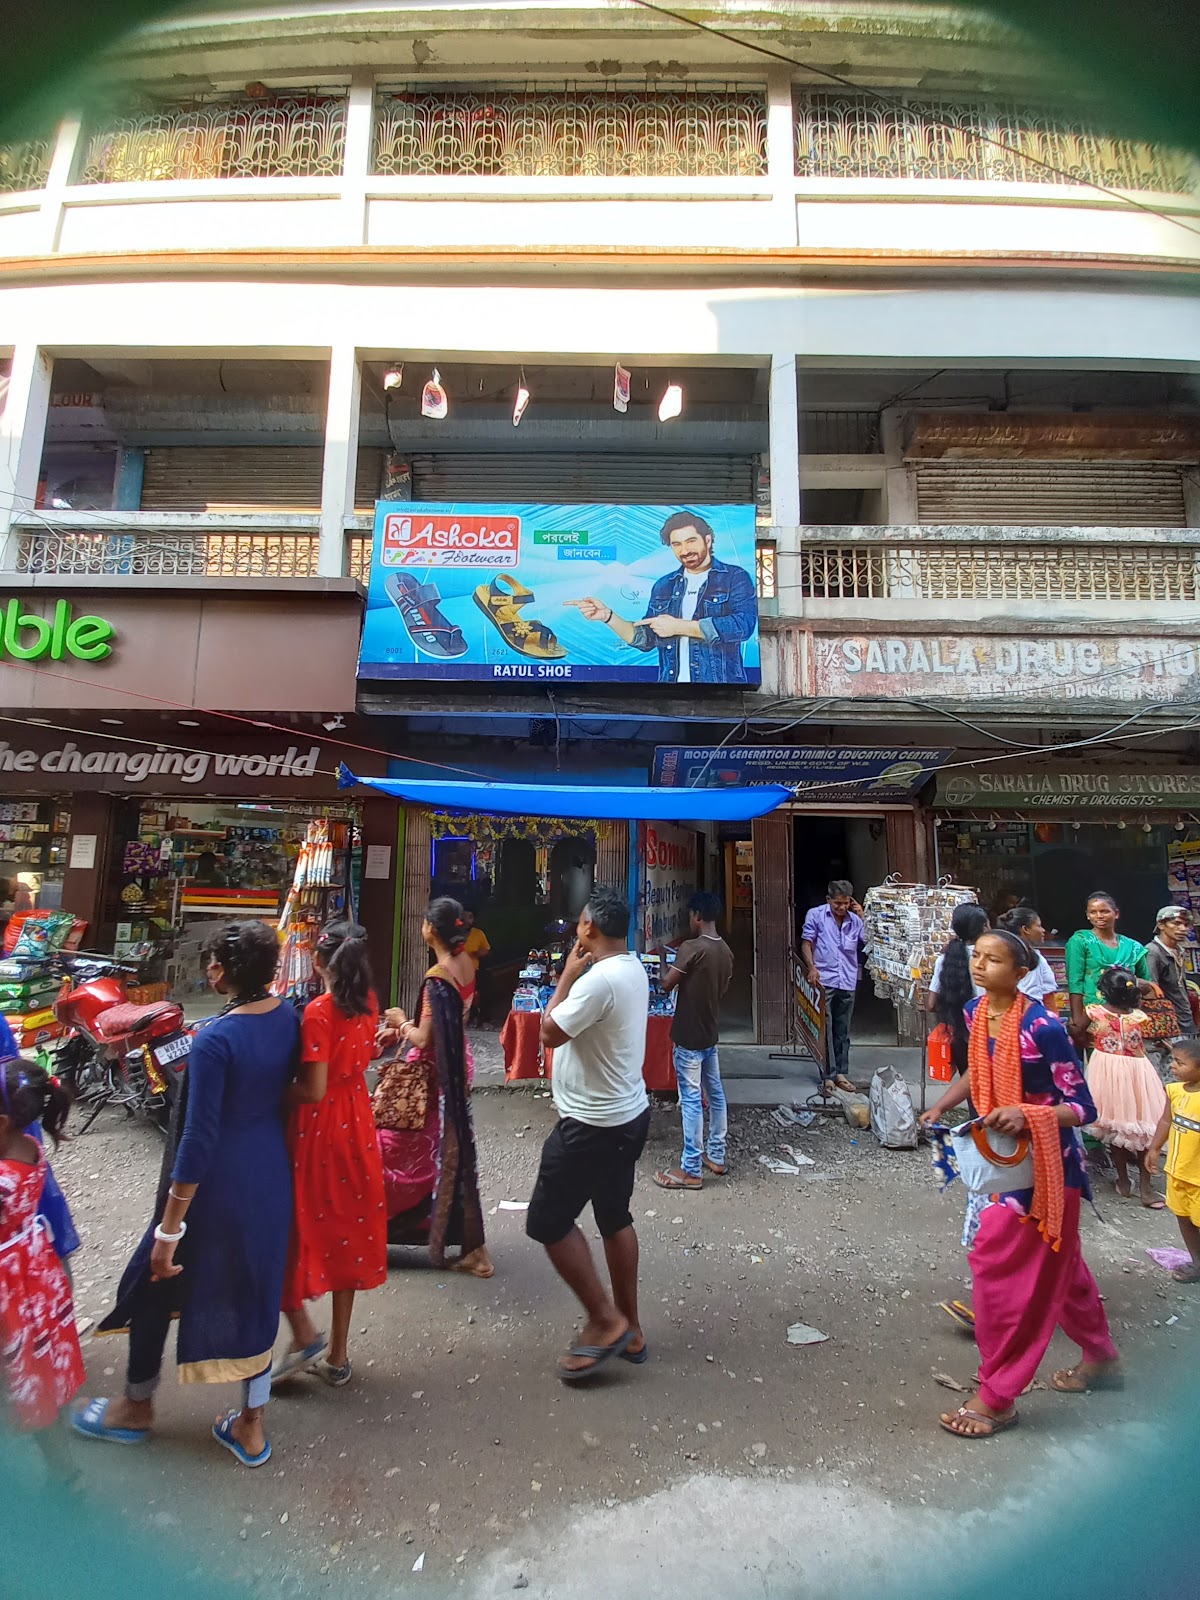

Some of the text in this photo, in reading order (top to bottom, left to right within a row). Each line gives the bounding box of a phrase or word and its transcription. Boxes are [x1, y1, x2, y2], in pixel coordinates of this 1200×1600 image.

[399, 522, 514, 547] Ashoka
[541, 532, 580, 544] পরলেই
[441, 549, 512, 565] Footwear
[0, 598, 116, 661] ble
[842, 639, 979, 674] SARALA
[995, 641, 1100, 676] DRUG
[1117, 642, 1200, 677] STO
[493, 665, 572, 677] RATUL SHOE
[41, 742, 212, 783] changing
[215, 747, 321, 777] world
[684, 750, 727, 759] MODERN
[729, 750, 789, 759] GENERATION
[837, 750, 898, 760] EDUCATION
[978, 773, 1054, 793] SARALA
[1059, 774, 1110, 793] DRUG
[1031, 794, 1157, 806] CHEMIST & DRUGGISTS
